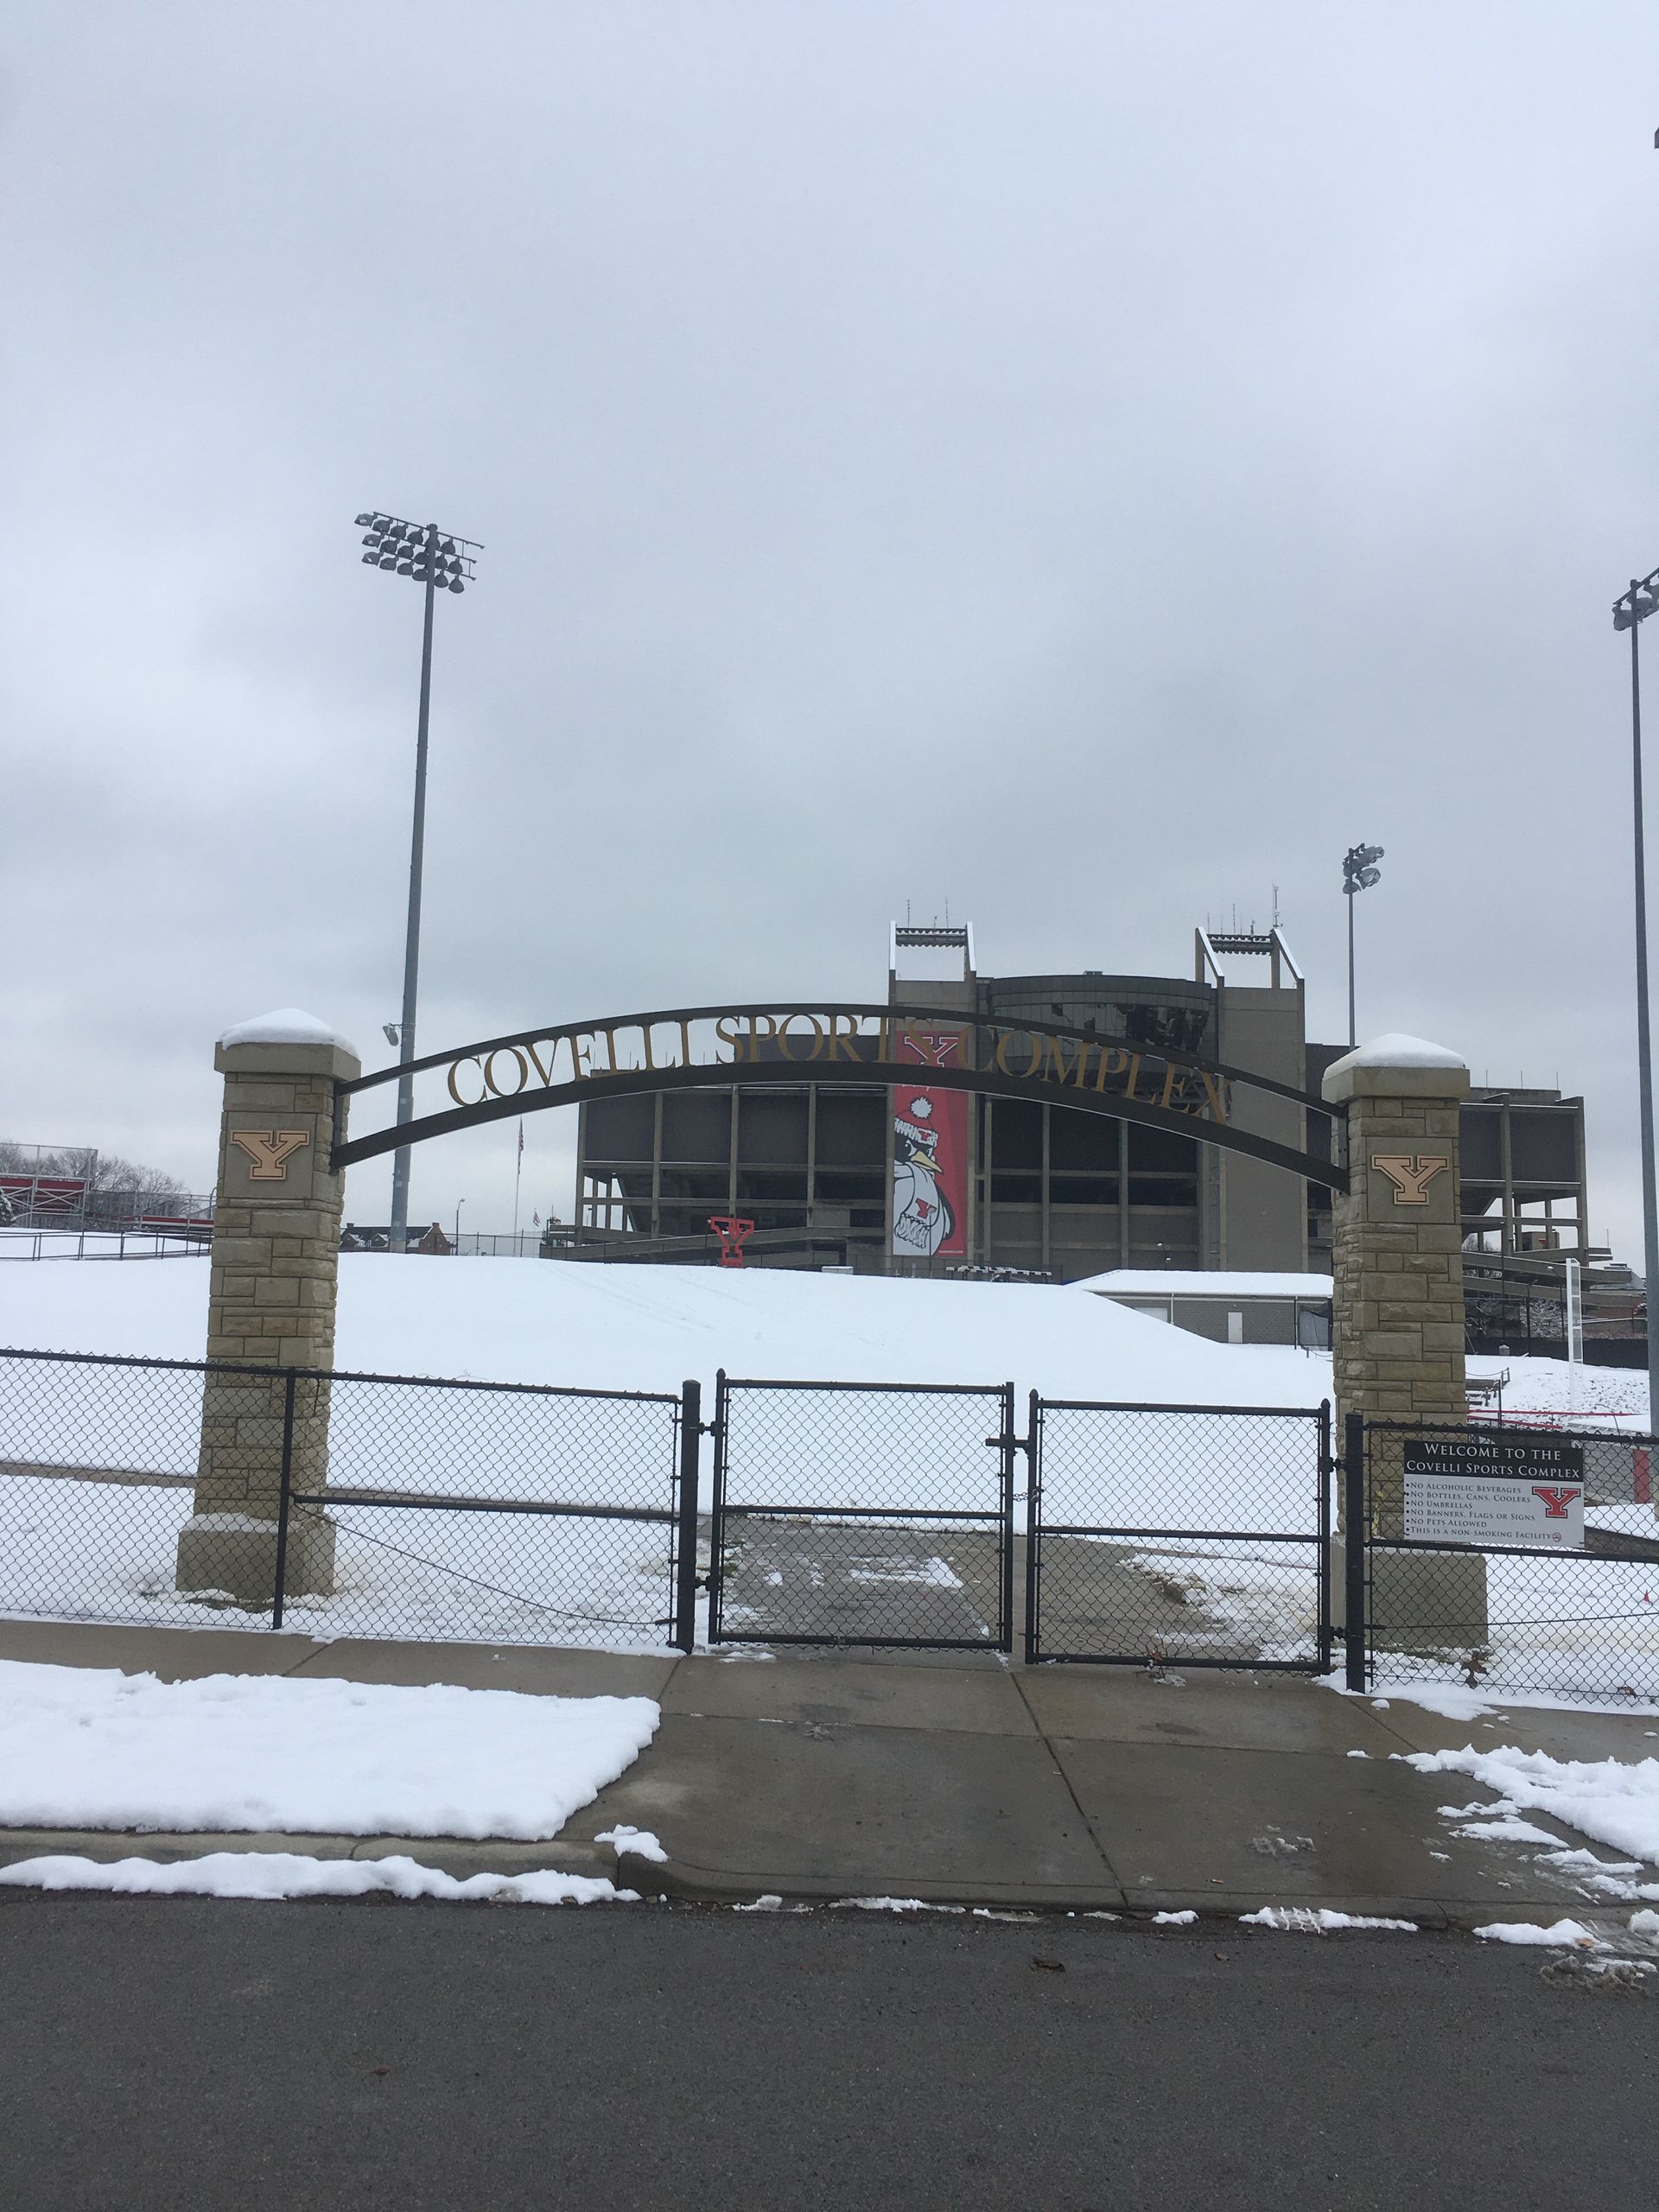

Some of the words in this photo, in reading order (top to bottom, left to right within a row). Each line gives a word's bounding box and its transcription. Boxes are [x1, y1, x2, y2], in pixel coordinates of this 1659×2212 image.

[448, 1020, 697, 1107] COVELLI
[715, 1014, 935, 1065] SPORTS
[956, 1023, 1236, 1125] COMPLEX
[231, 1129, 310, 1180] Y
[1371, 1154, 1450, 1205] Y
[1424, 1443, 1499, 1459] WELCOME
[1505, 1448, 1526, 1459] TO
[1531, 1449, 1561, 1461] THE
[1406, 1459, 1460, 1473] COVELLI
[1465, 1463, 1513, 1476] SPORTS
[1518, 1465, 1580, 1478] COMPLEX
[1426, 1483, 1474, 1491] ALCOHOLIC
[1494, 1494, 1531, 1503] COOLERS
[1531, 1486, 1581, 1519] Y
[1516, 1531, 1552, 1540] FACILITY
